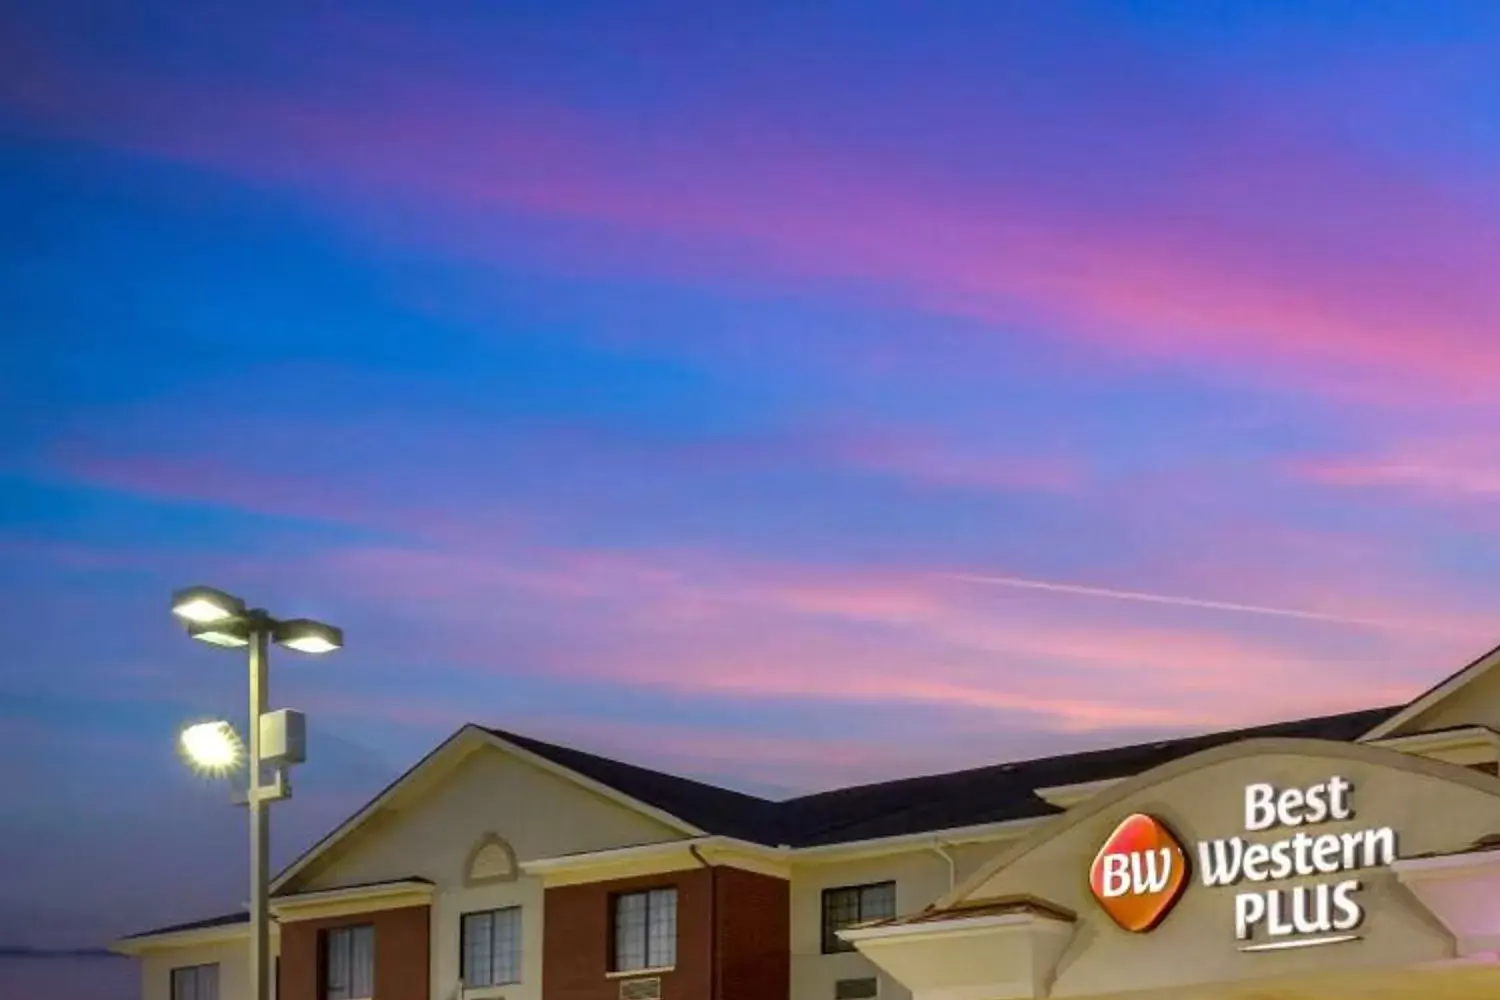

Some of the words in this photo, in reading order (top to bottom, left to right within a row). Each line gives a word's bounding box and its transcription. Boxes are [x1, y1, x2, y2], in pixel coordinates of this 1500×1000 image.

[1245, 775, 1350, 831] Best
[1102, 847, 1171, 898] BW
[1198, 826, 1396, 887] Western
[1235, 880, 1361, 940] PLUS
